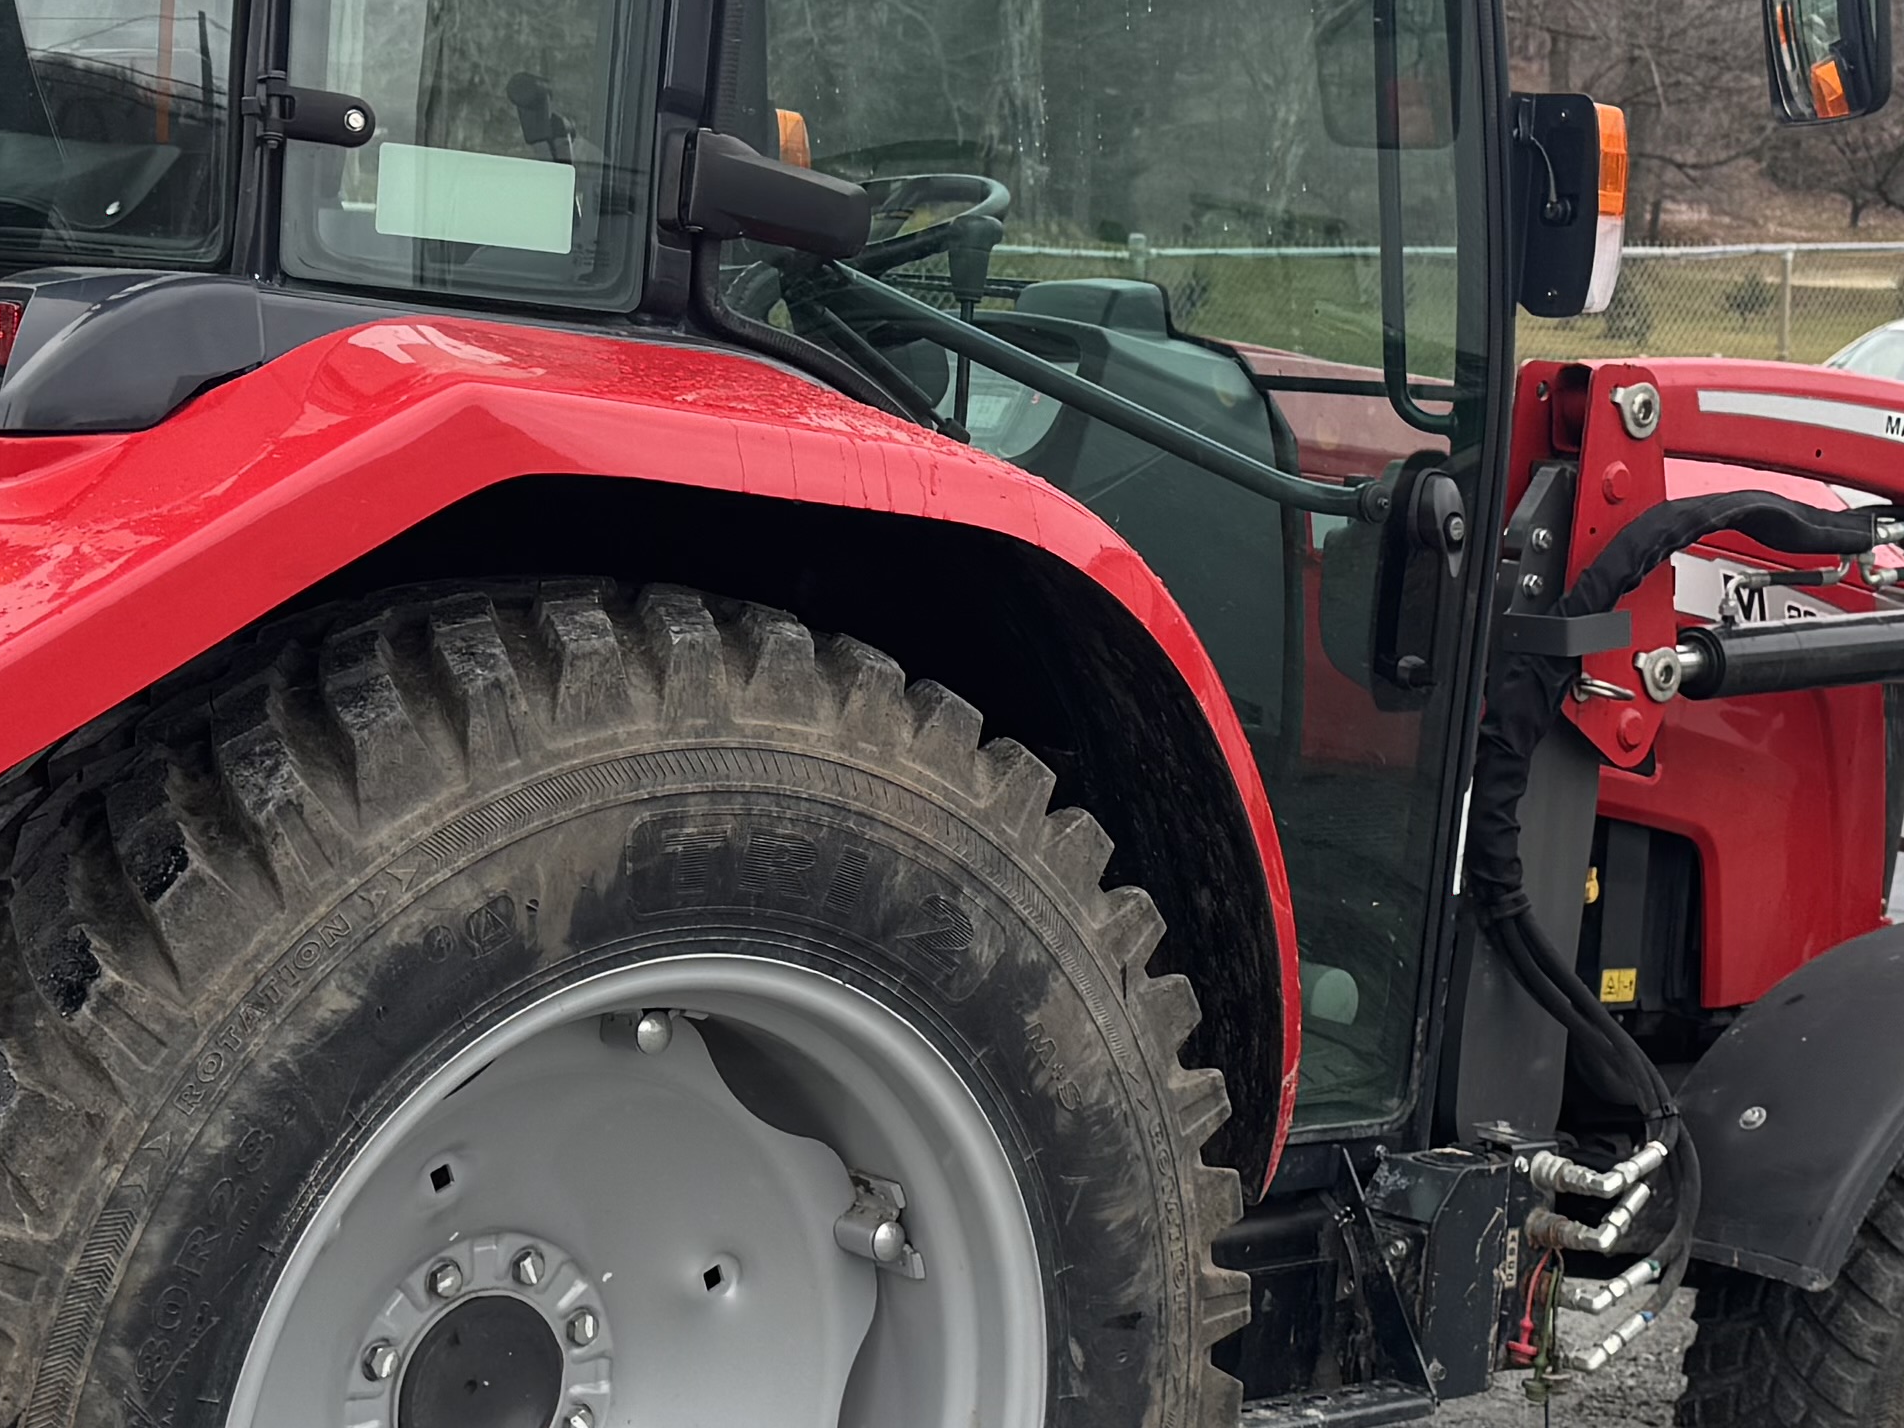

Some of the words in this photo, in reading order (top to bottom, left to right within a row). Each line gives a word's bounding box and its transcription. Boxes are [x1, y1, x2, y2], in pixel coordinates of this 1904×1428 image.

[657, 824, 876, 917] TRI
[893, 880, 986, 981] 2
[170, 898, 353, 1124] ROTATION
